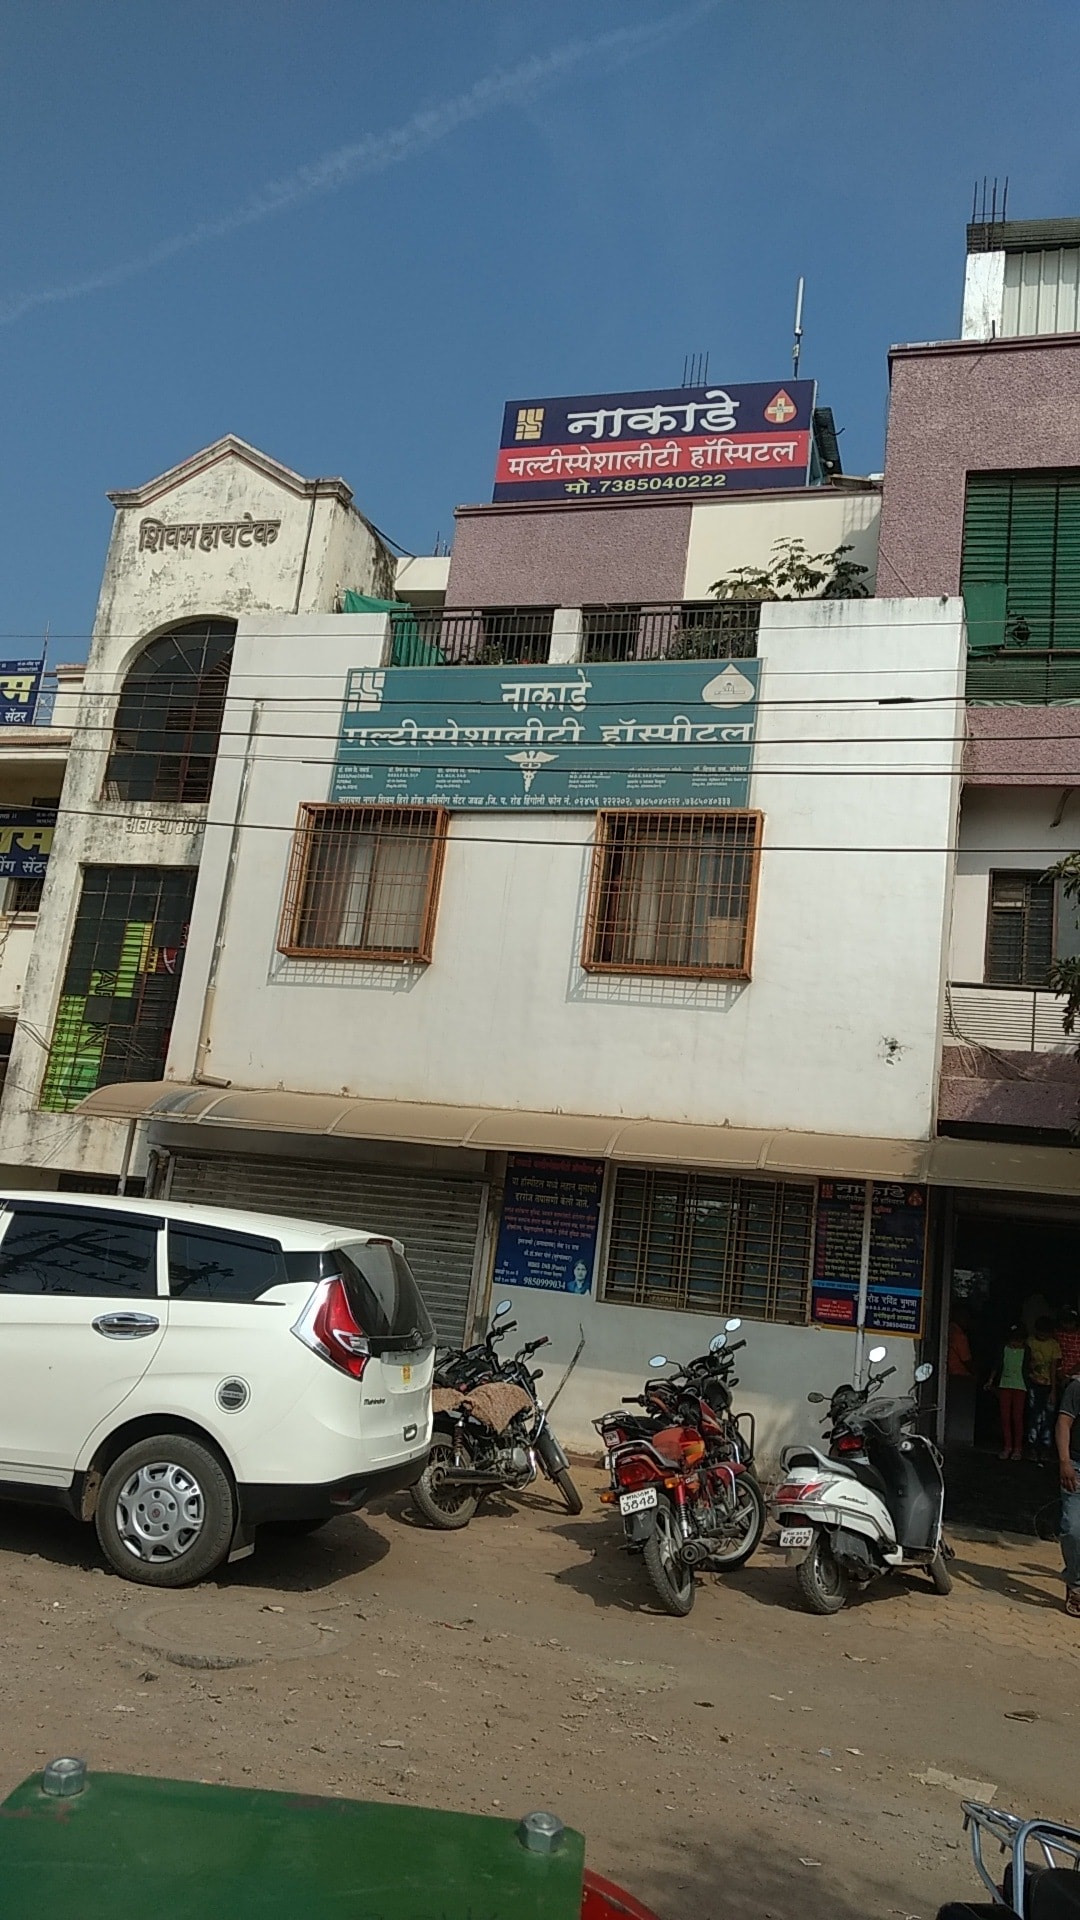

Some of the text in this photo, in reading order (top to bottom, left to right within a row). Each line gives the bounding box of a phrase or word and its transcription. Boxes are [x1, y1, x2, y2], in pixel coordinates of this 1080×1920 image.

[566, 389, 740, 439] नाकाडे
[507, 436, 798, 477] मल्टीस्पेशालीटी हॉस्पिटल
[565, 474, 727, 494] मो.7385040222
[138, 512, 281, 554] शिवम हायटेक
[500, 668, 592, 712] नाकाडे
[343, 715, 755, 748] मल्टीस्पेशालीटी हॉस्पीटल
